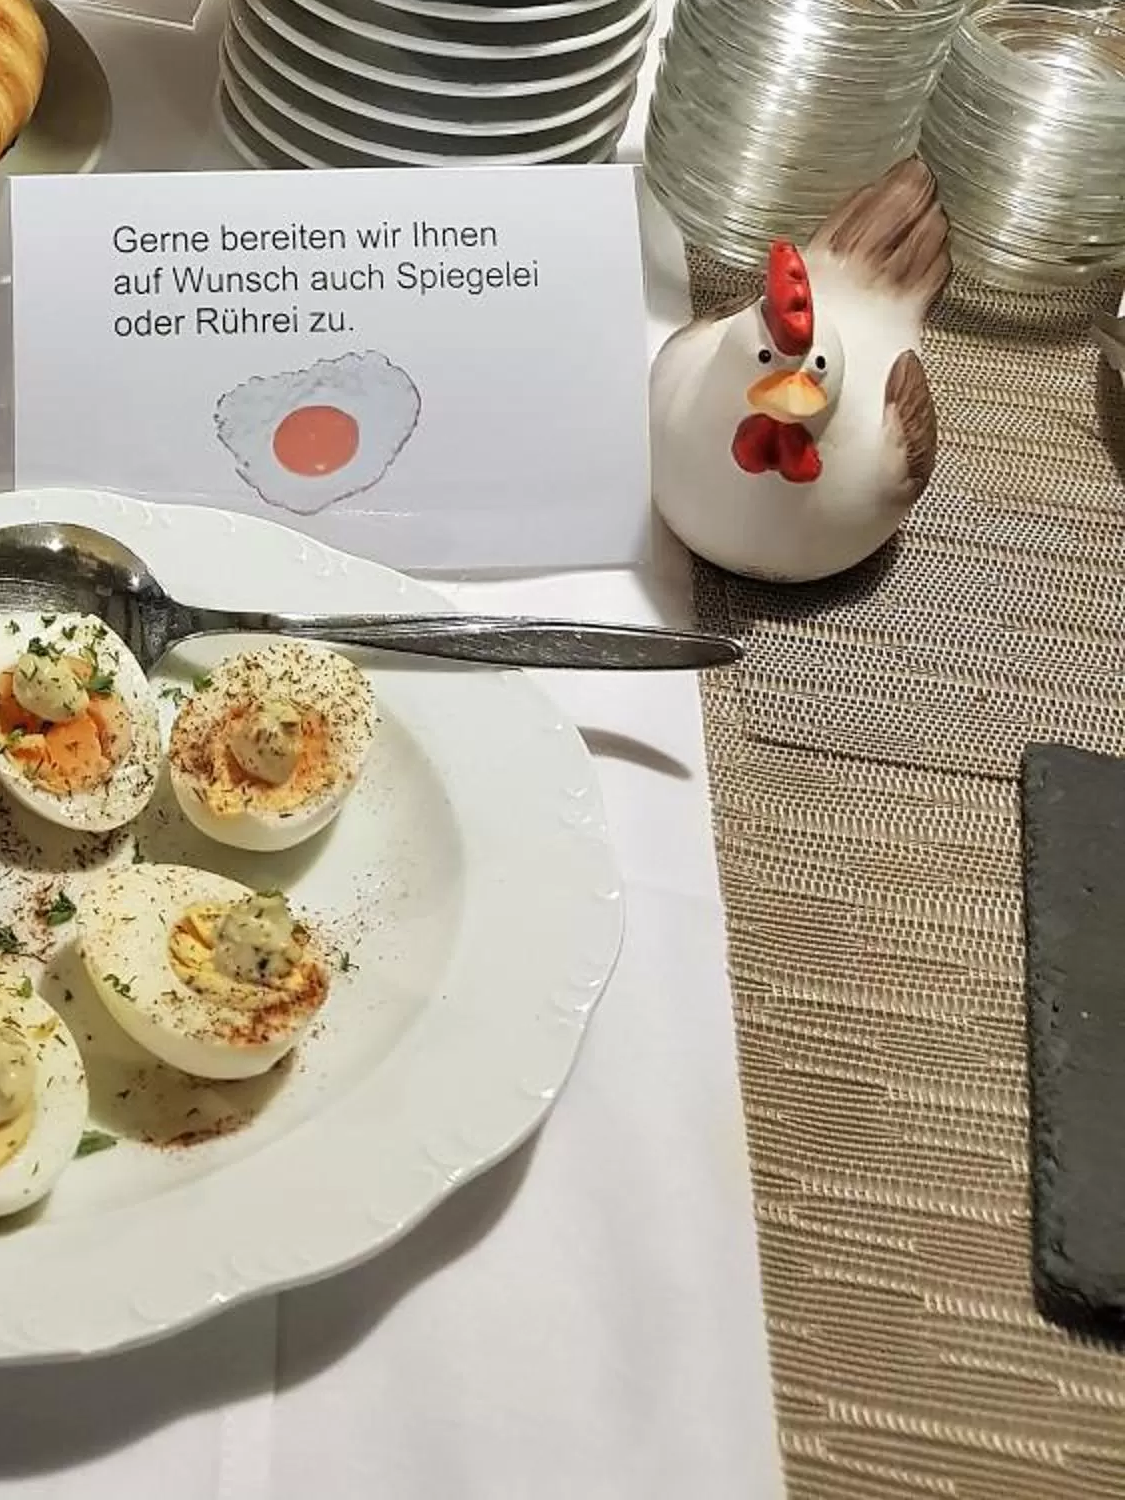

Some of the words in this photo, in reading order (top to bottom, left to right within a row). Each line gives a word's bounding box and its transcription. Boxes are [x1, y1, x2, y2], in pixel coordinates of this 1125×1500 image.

[112, 225, 210, 253] Gerne
[220, 223, 347, 251] bereiten
[356, 222, 402, 249] wir
[412, 221, 498, 248] Ihnen
[113, 266, 164, 296] auf
[172, 264, 300, 294] Wunsch
[310, 262, 385, 291] auch
[395, 259, 539, 296] Spiegelei
[113, 308, 186, 337] oder
[195, 305, 299, 336] Rührei
[309, 310, 355, 334] zu.
